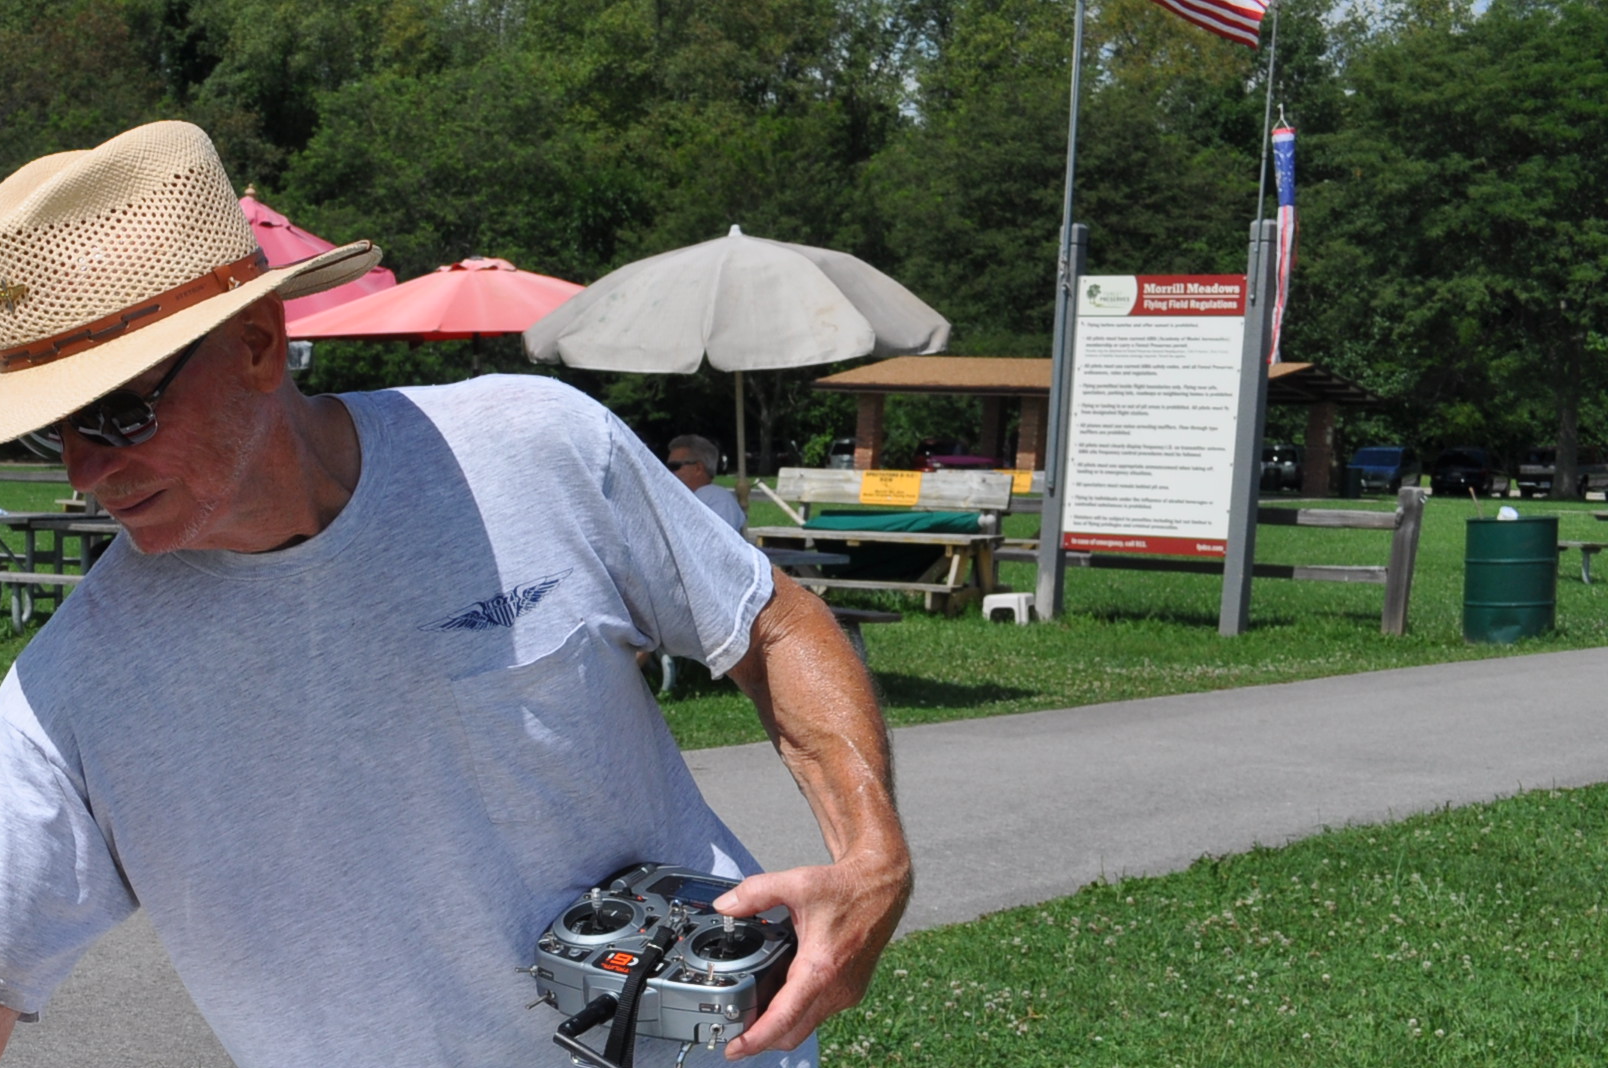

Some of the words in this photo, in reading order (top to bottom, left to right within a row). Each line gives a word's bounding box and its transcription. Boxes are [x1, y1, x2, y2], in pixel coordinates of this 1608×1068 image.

[1143, 283, 1184, 294] Morrill
[1186, 283, 1240, 294] Meadows
[1143, 300, 1168, 311] Flying
[1168, 300, 1189, 310] Field
[1190, 300, 1238, 311] Regulations
